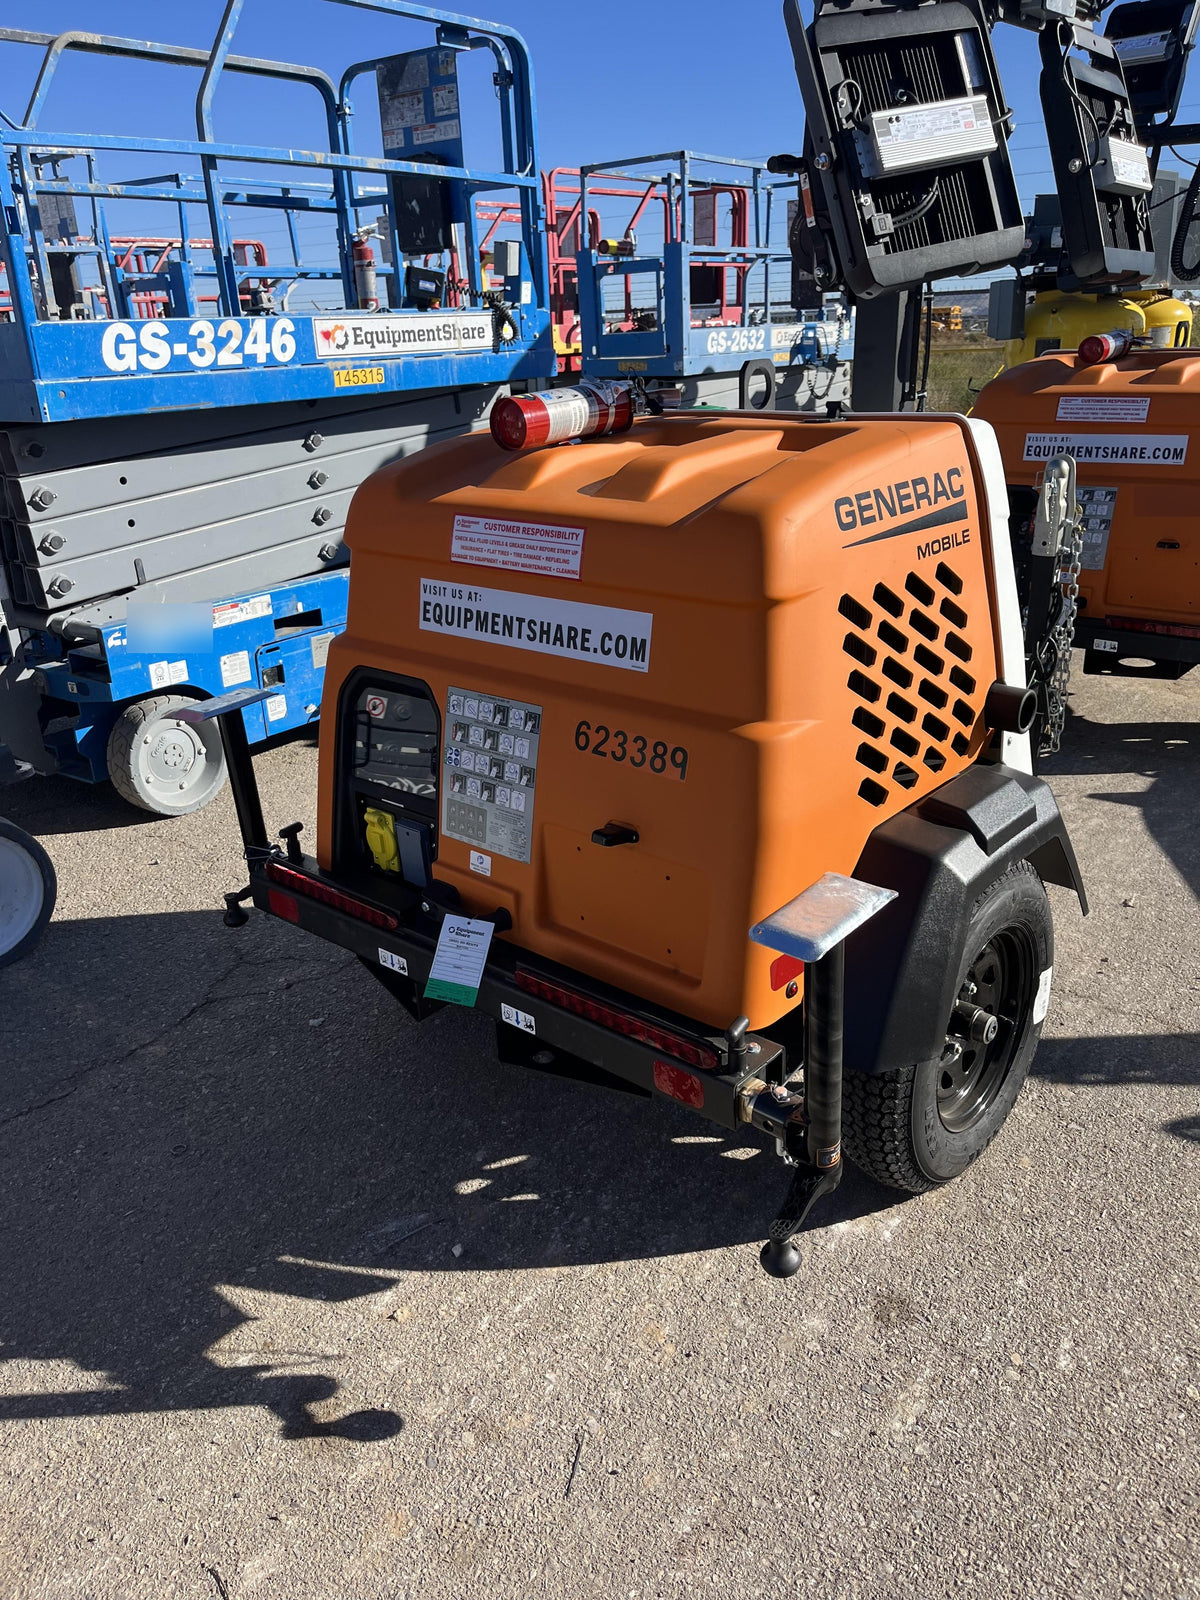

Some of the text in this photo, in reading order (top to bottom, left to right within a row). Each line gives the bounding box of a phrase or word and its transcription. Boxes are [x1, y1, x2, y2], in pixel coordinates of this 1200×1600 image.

[102, 318, 296, 372] GS-3246
[352, 324, 485, 348] EquipmentShare
[707, 329, 766, 353] GS-2632
[336, 368, 384, 386] 145315
[1026, 446, 1184, 460] EQUIPMENTSHARE.COM
[834, 467, 965, 531] GENERAC
[484, 522, 579, 540] CUSTOMER RESPONSIBILITY
[539, 545, 556, 554] BEFORE
[917, 529, 970, 560] MOBILE
[474, 556, 498, 564] EQUIPMENT
[521, 562, 552, 572] MAINTENANCE
[556, 567, 578, 575] CLEANING
[523, 552, 541, 560] DAMAGE
[545, 556, 570, 564] REFUELING
[423, 584, 482, 602] VISIT US AT:
[423, 601, 646, 662] EQUIPMENTSHARE.COM
[575, 721, 688, 780] 623389
